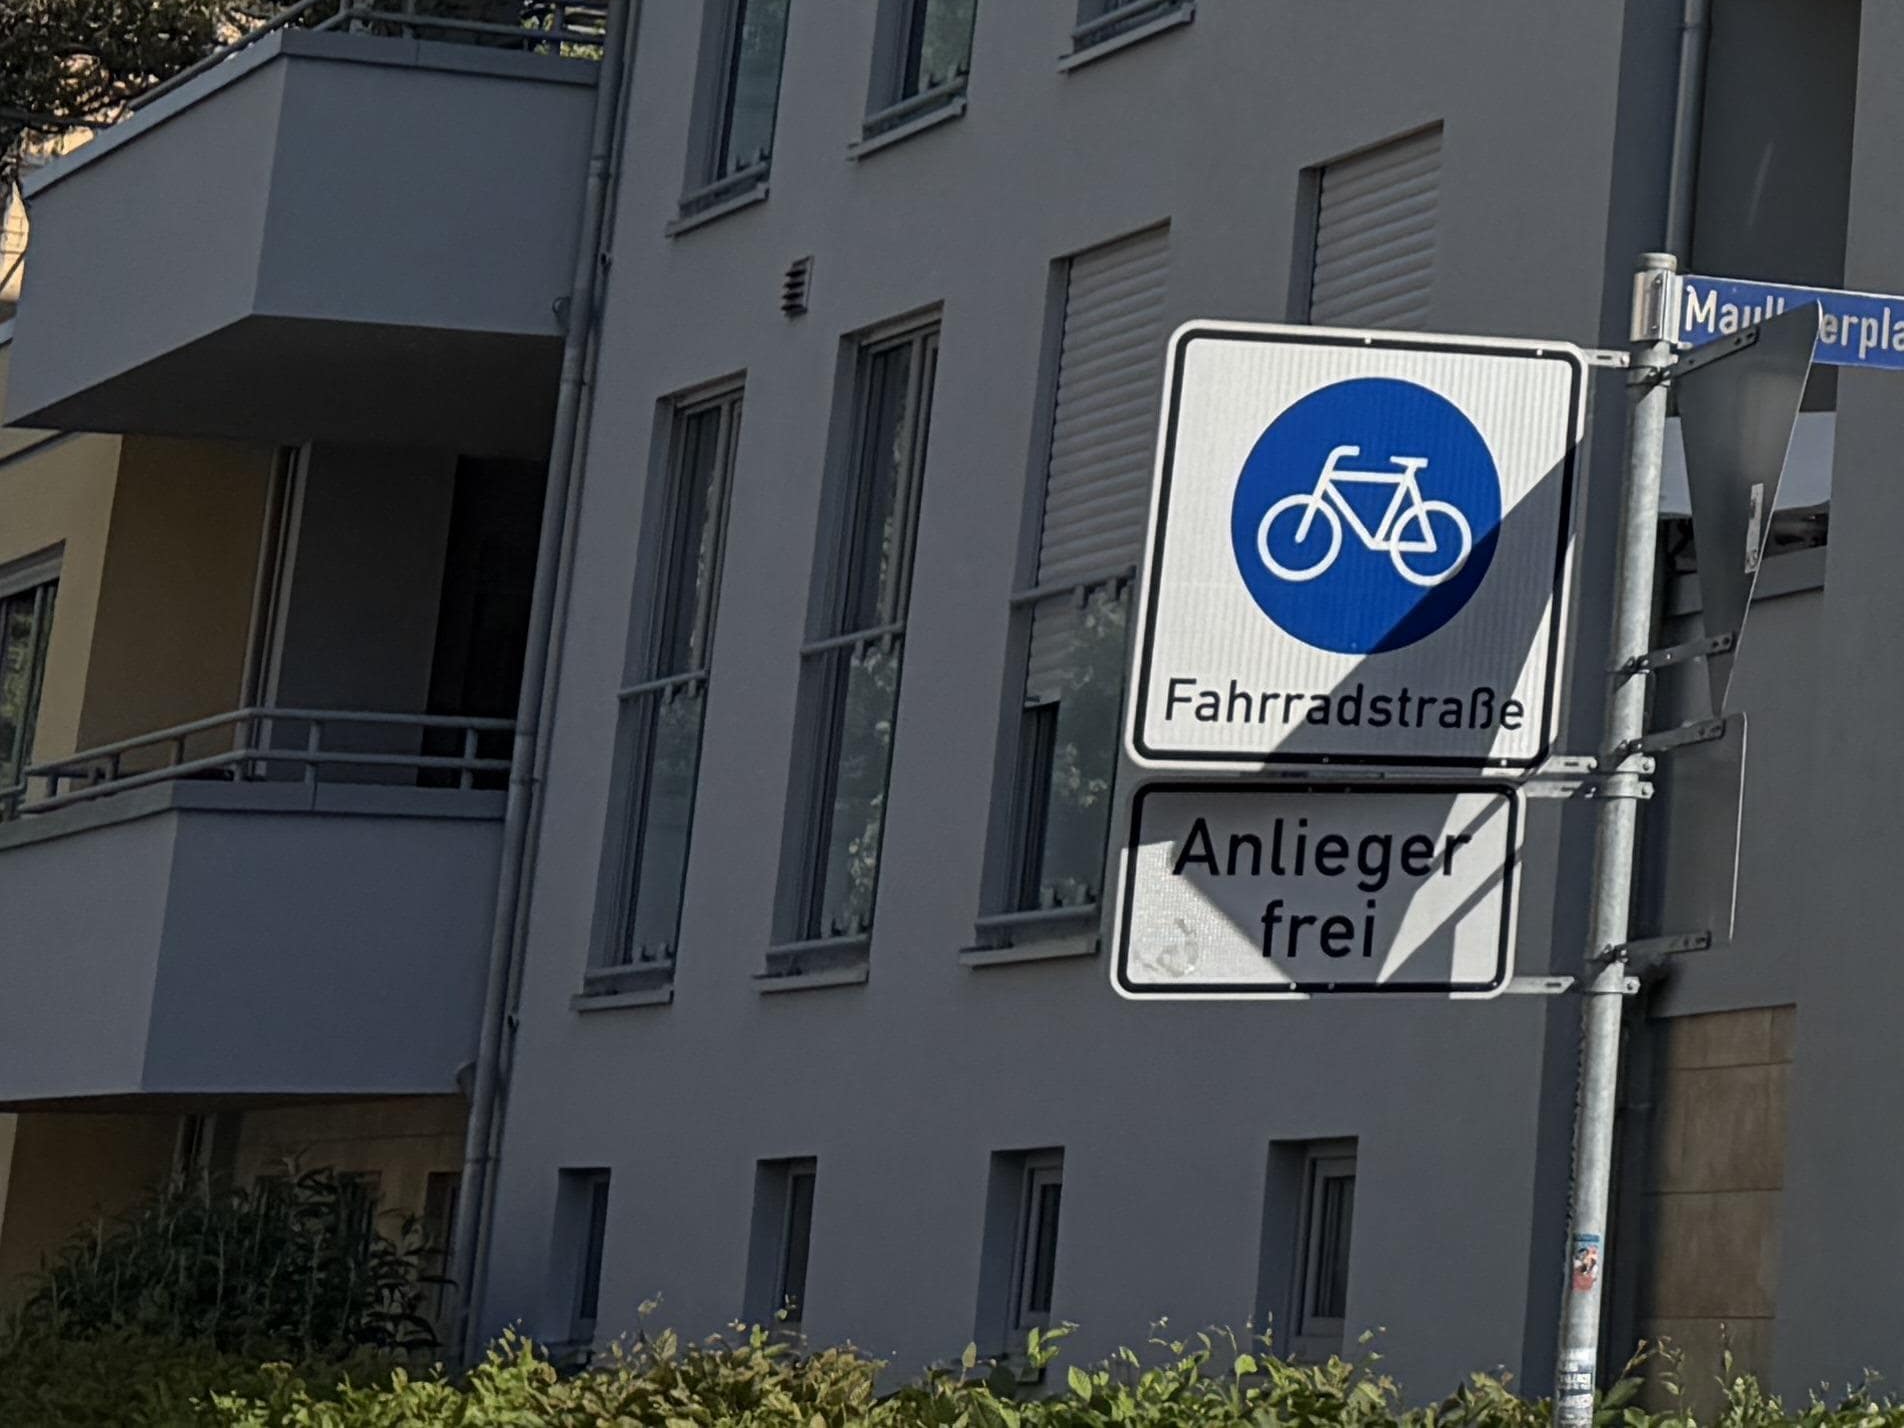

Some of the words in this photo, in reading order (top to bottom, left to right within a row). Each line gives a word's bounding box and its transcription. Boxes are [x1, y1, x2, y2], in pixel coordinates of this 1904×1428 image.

[1164, 678, 1525, 730] Fahrradstraße
[1172, 817, 1472, 893] Anlieger
[1261, 900, 1377, 958] frei
